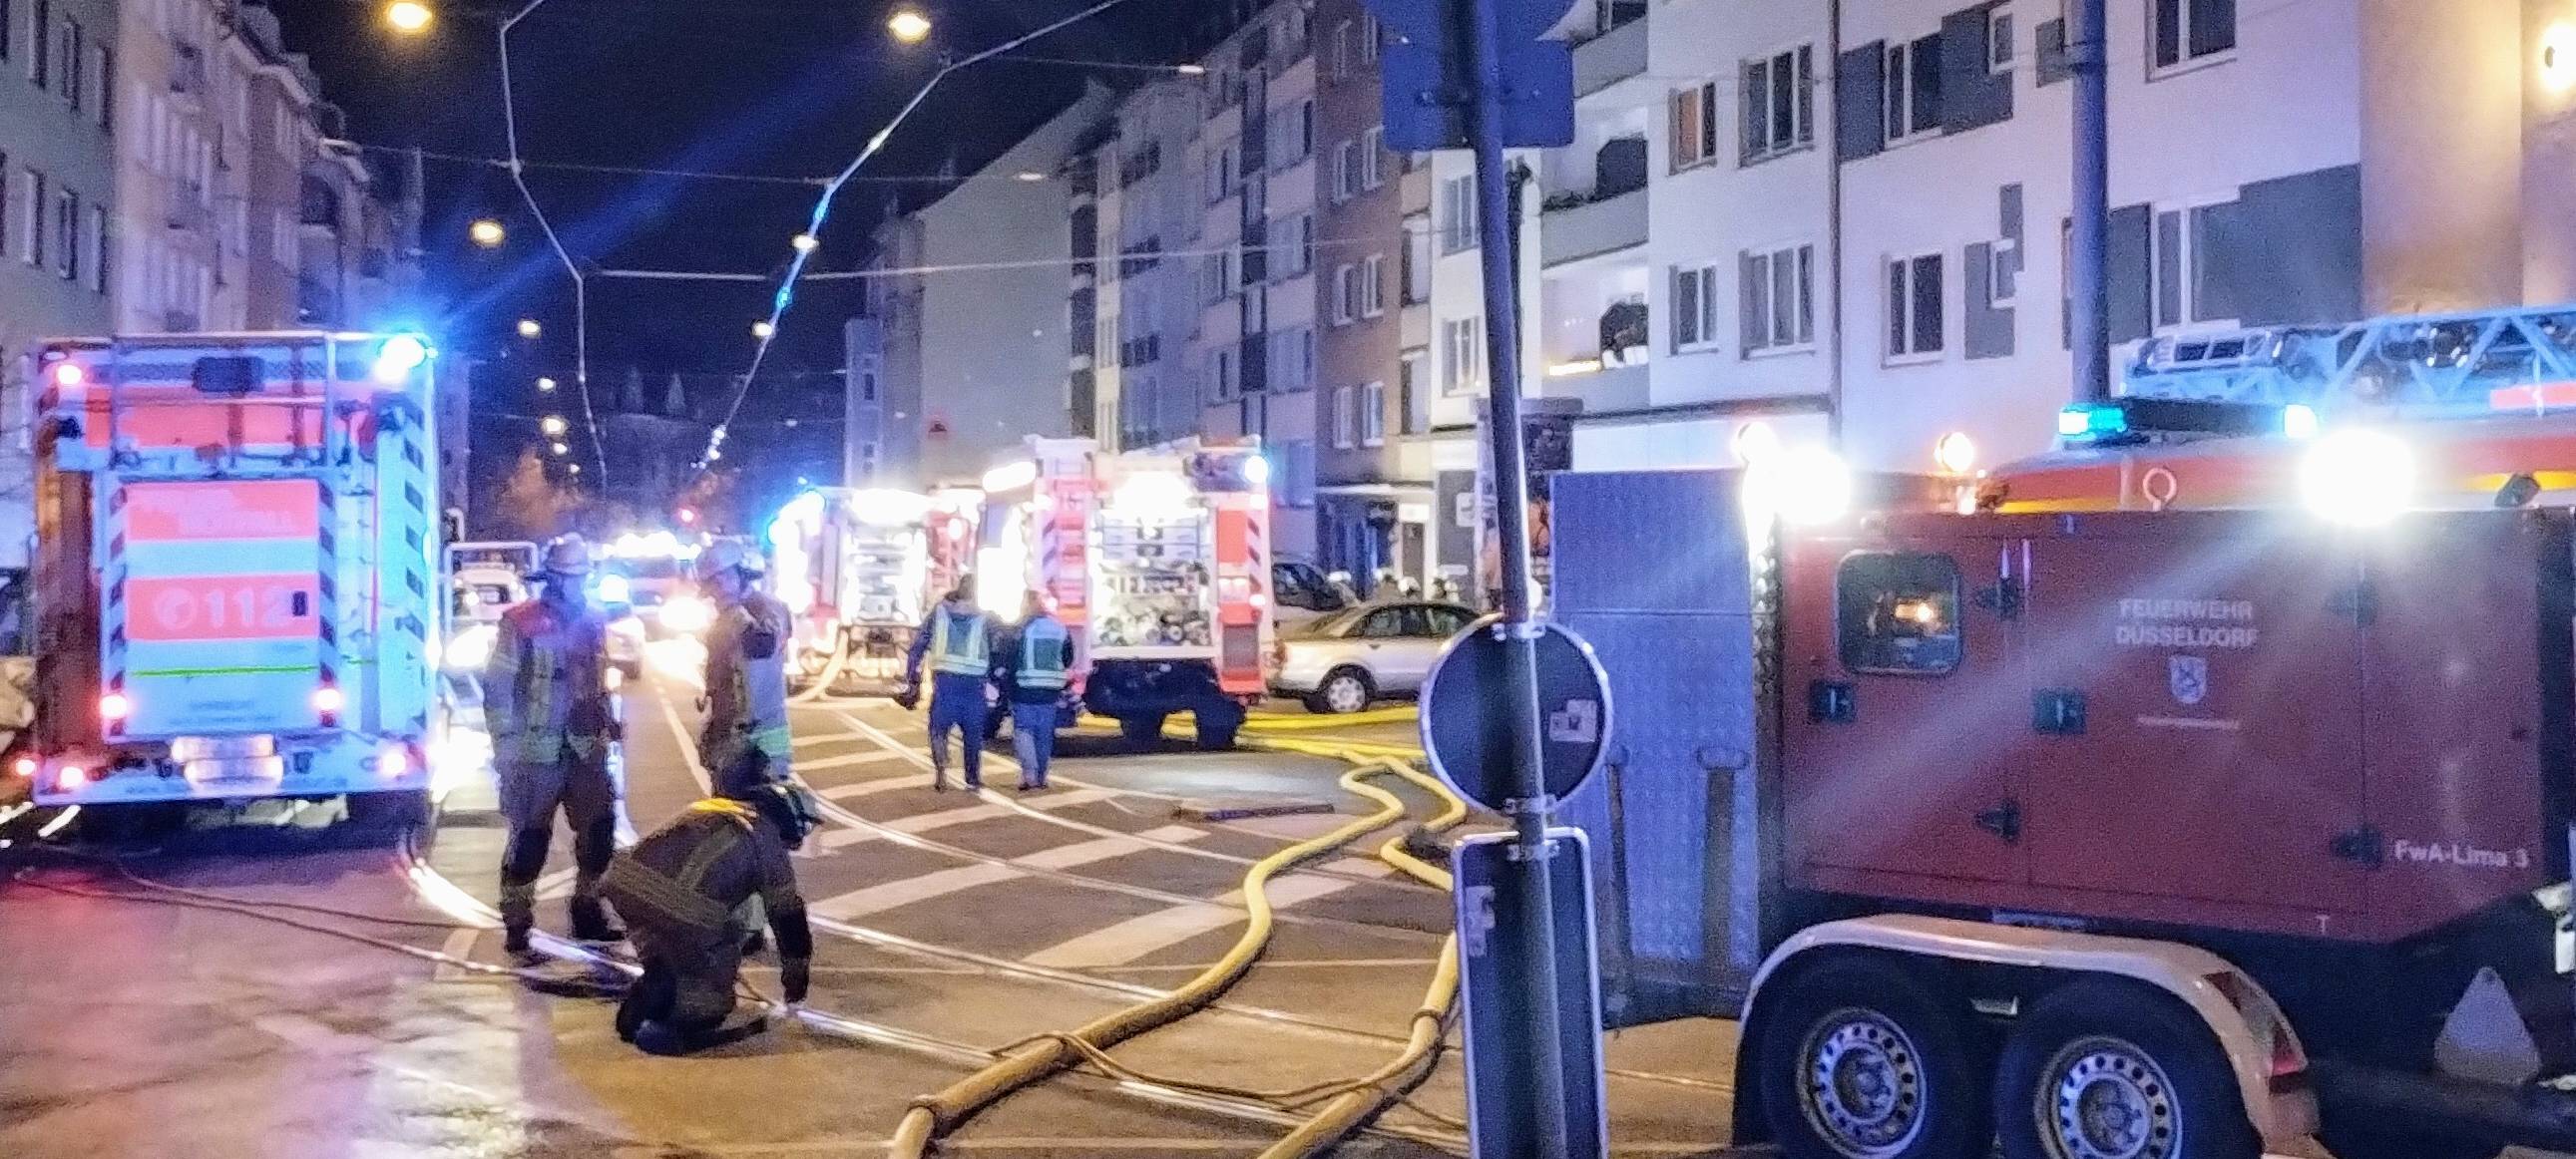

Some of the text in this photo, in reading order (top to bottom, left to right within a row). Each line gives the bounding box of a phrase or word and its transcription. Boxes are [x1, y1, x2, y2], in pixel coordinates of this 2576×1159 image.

[205, 585, 293, 629] 112
[2119, 598, 2253, 619] FEUERWEHR
[2115, 622, 2259, 647] DÜSSELDORF
[2394, 838, 2529, 869] FwA-Lima 3
